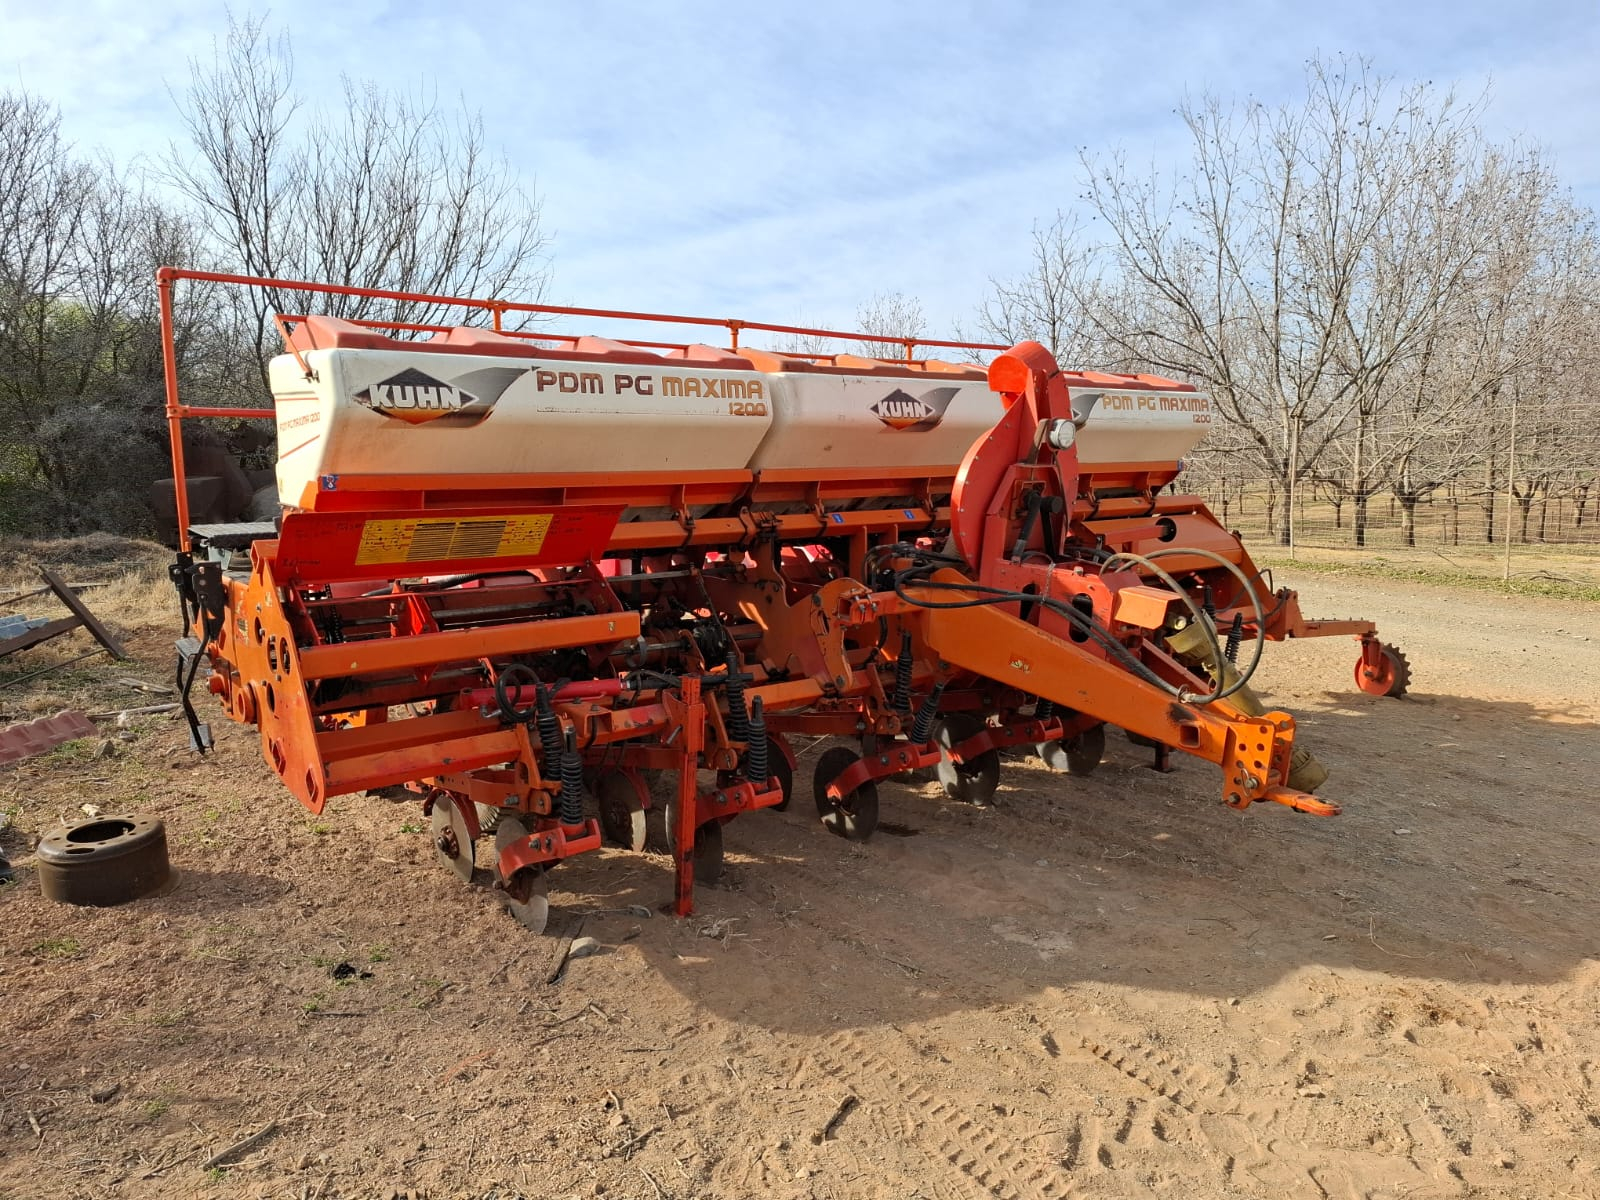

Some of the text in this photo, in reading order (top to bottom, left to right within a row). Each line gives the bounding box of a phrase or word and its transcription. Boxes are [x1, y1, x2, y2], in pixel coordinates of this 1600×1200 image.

[537, 370, 763, 399] PDM PG MAXIMA
[368, 384, 461, 410] KUHN
[1102, 395, 1210, 412] PDM PG MAXIMA
[728, 401, 768, 416] 1200
[877, 400, 927, 418] KUHN
[1192, 414, 1211, 424] 1200
